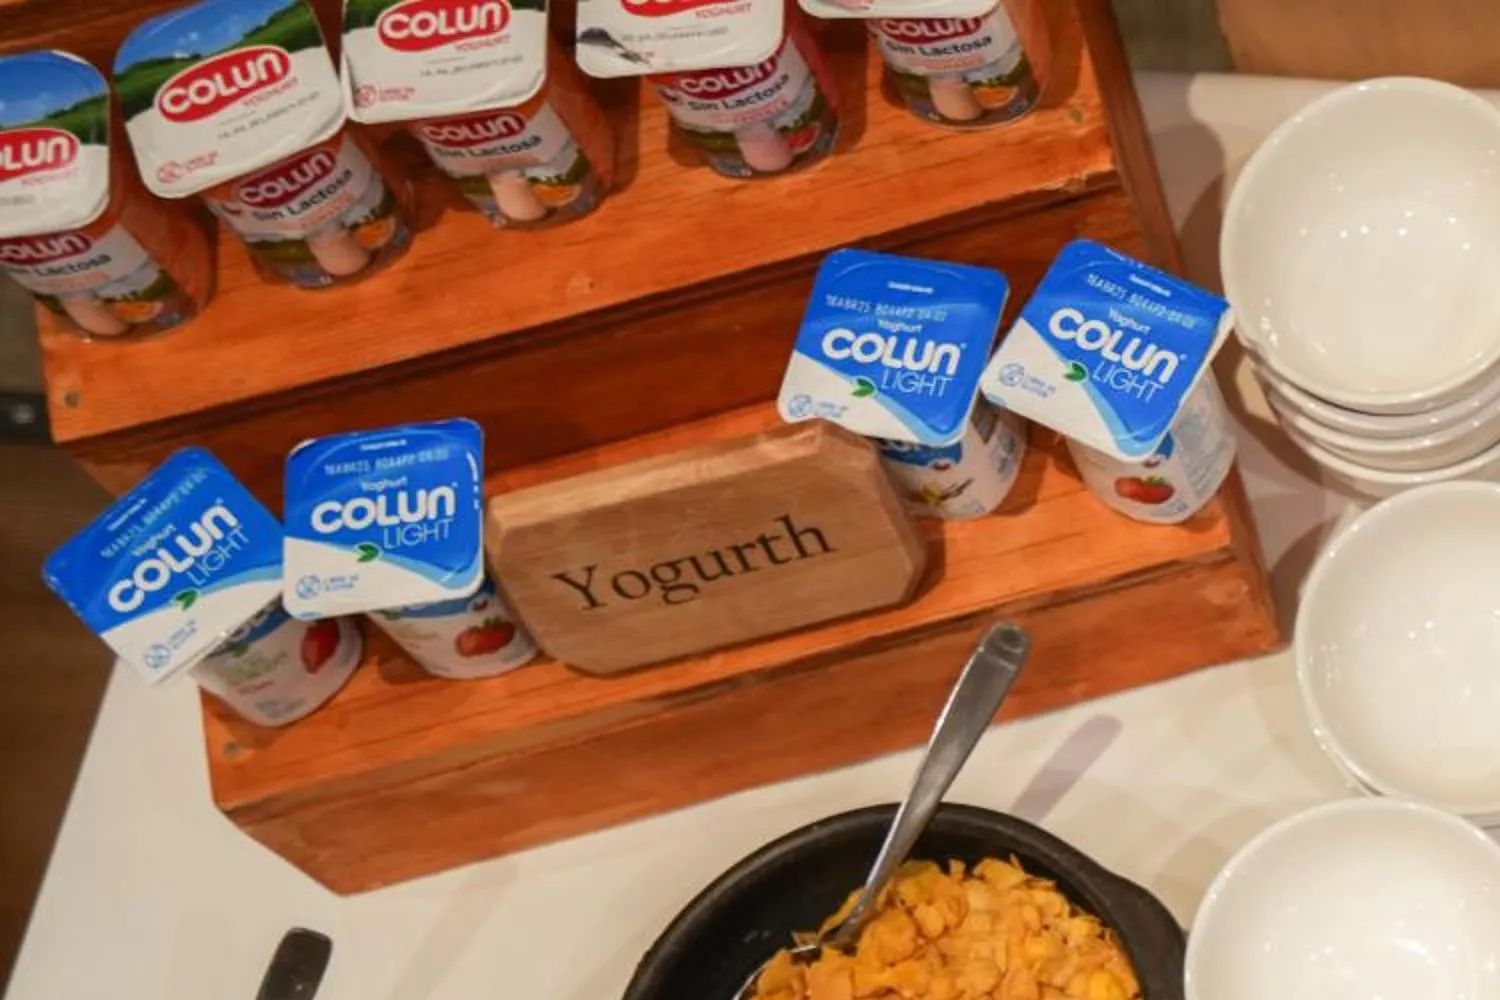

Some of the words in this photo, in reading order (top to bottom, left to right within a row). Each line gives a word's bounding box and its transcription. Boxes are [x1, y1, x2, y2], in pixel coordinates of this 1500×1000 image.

[382, 2, 502, 40] COLUN
[919, 36, 992, 57] Lactosa
[161, 52, 283, 114] COLUN
[721, 73, 789, 110] Lactosa
[422, 114, 521, 141] COLUN
[0, 136, 70, 171] LUN
[240, 153, 333, 204] COLUN
[0, 235, 84, 260] OLUN
[822, 327, 961, 376] COLUN
[1048, 307, 1179, 384] COLUN
[881, 367, 953, 398] LIGHT
[1091, 359, 1165, 404] LIGHT
[311, 485, 456, 534] COLUN
[186, 523, 250, 586] LIGHT
[383, 518, 453, 549] LIGHT
[107, 504, 239, 613] COLUN
[552, 514, 836, 611] Yogurth
